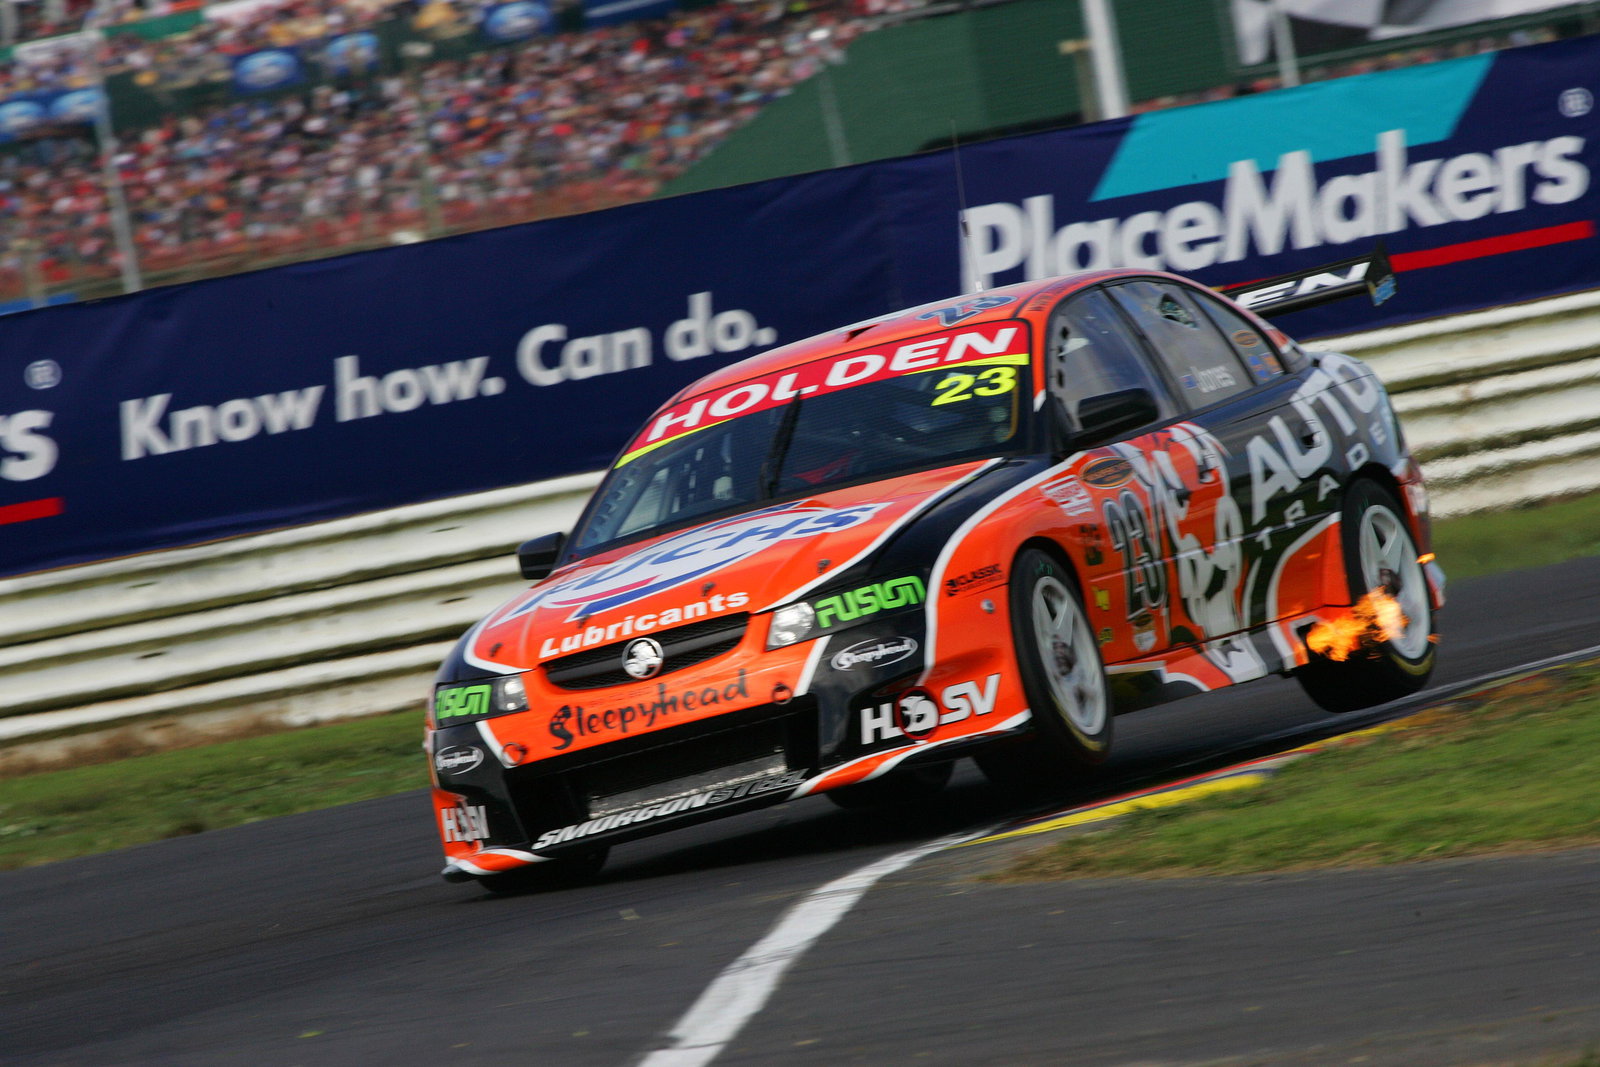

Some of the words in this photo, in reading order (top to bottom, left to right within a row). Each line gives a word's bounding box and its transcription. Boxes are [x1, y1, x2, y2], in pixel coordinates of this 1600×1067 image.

[959, 129, 1591, 295] PlaceMakers
[120, 385, 325, 461] Know
[334, 355, 507, 423] how.
[516, 323, 653, 387] Can
[663, 291, 778, 362] do.
[646, 327, 1018, 443] HOLDEN
[931, 366, 1017, 407] 23
[1246, 354, 1380, 526] AUTO
[507, 505, 878, 617] FUCHS
[814, 575, 926, 629] FUSION
[539, 591, 750, 658] Lubricants
[549, 667, 749, 751] Sleepyhead
[531, 789, 719, 850] SMORGON
